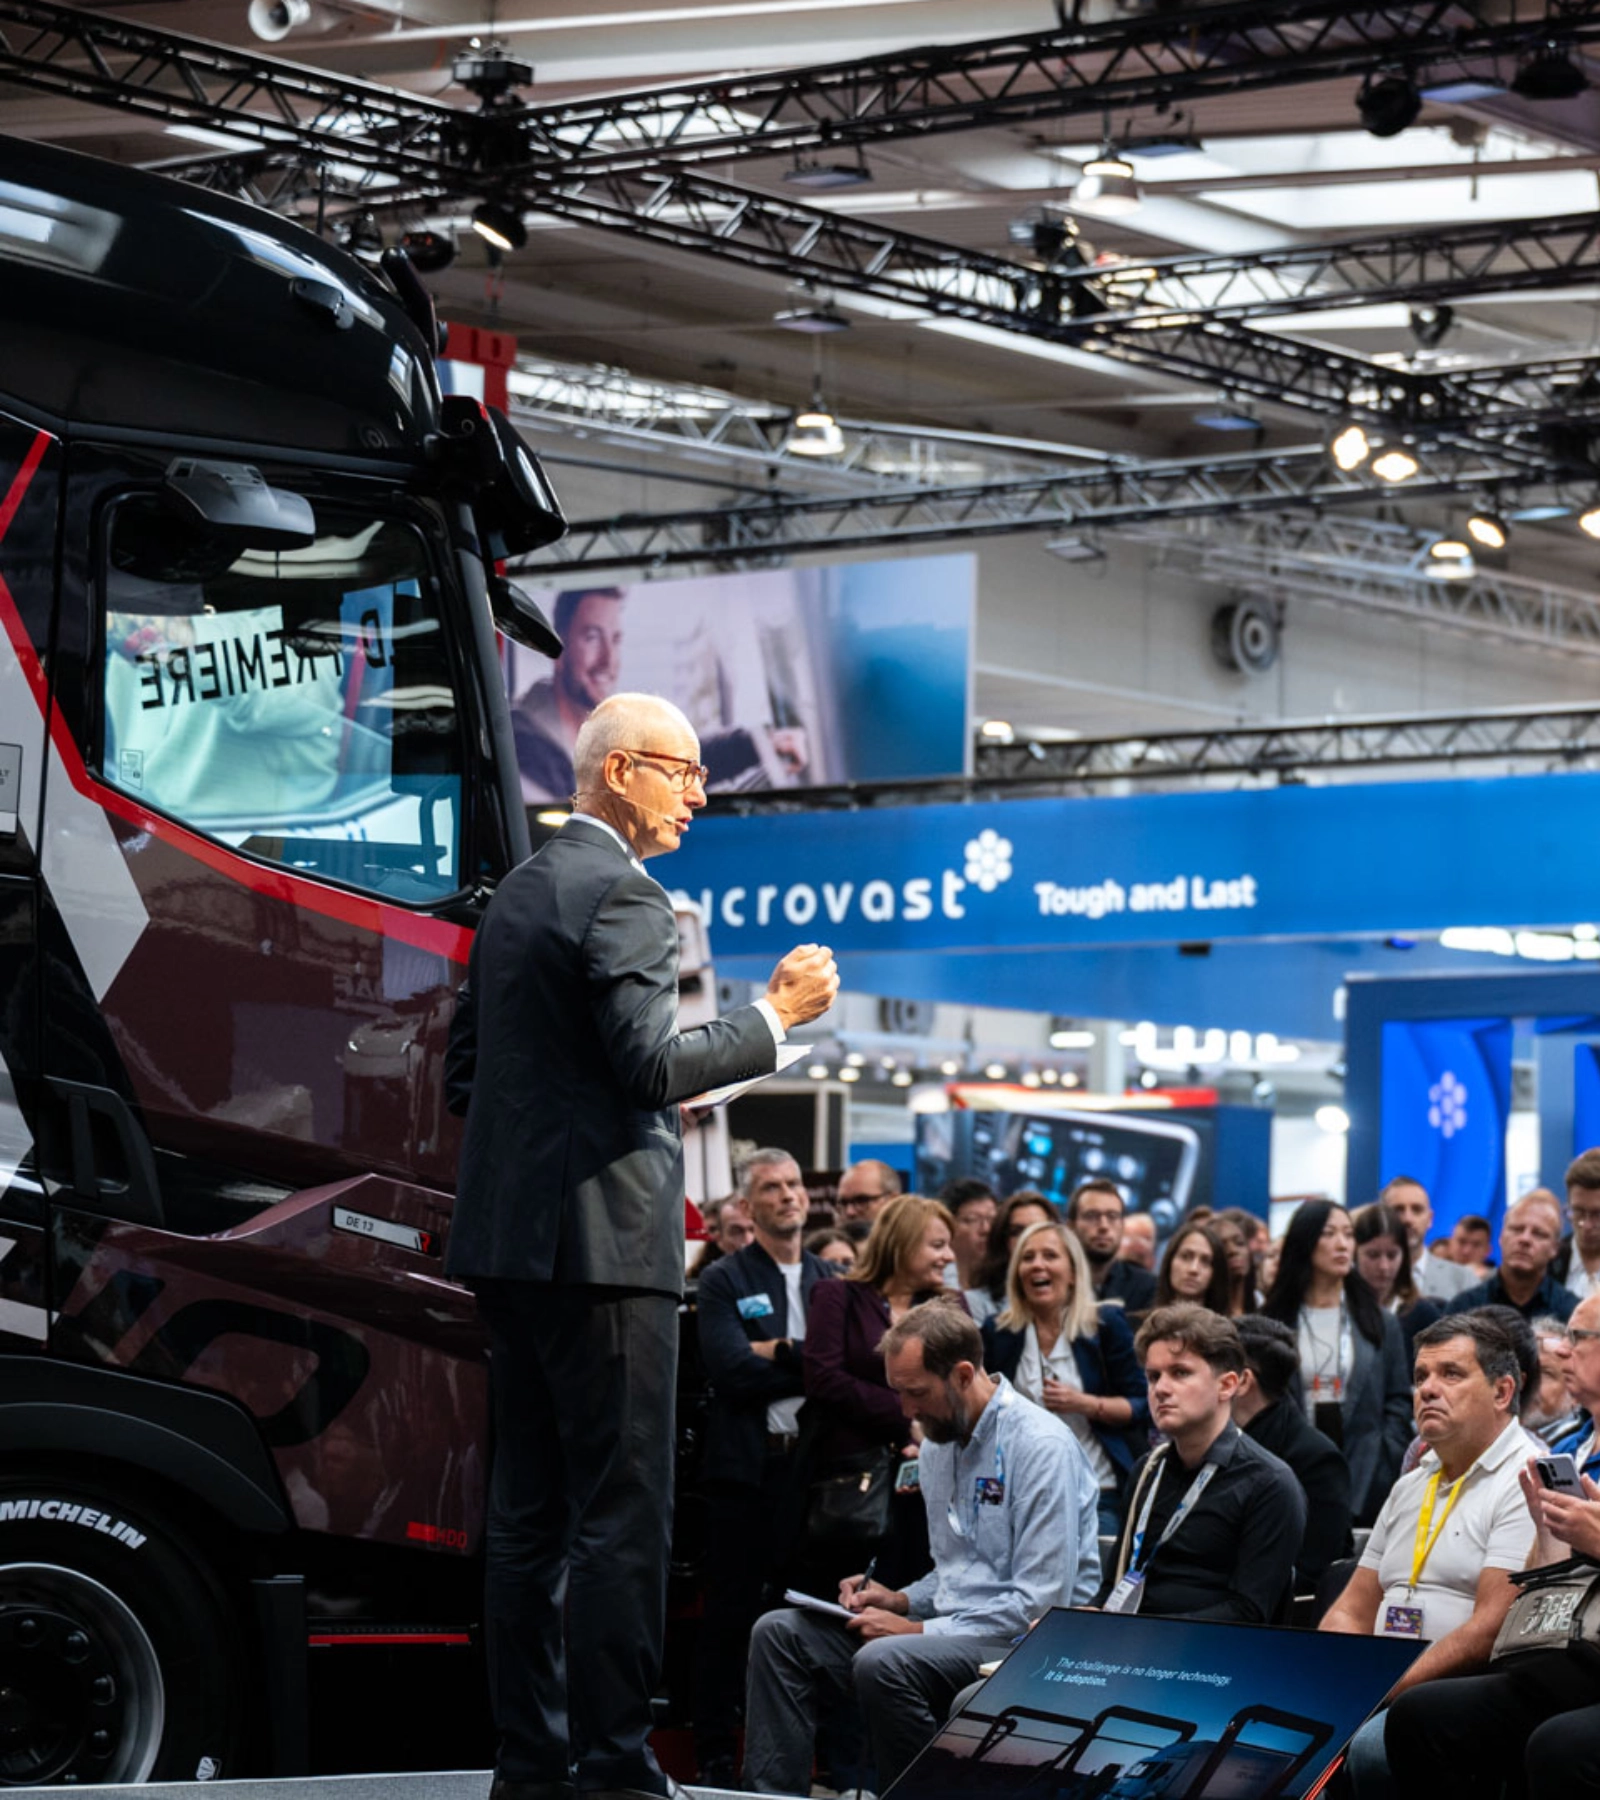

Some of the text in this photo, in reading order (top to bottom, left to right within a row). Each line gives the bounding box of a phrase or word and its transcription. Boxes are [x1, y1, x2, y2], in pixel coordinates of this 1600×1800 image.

[1034, 874, 1258, 919] Tough and Last
[346, 1216, 375, 1233] DE 13
[0, 1499, 148, 1550] MICHELIN
[1056, 1657, 1075, 1669] The
[1074, 1660, 1121, 1675] challenge
[1120, 1664, 1132, 1674] is
[1131, 1667, 1146, 1676] no
[1144, 1666, 1179, 1681] longer
